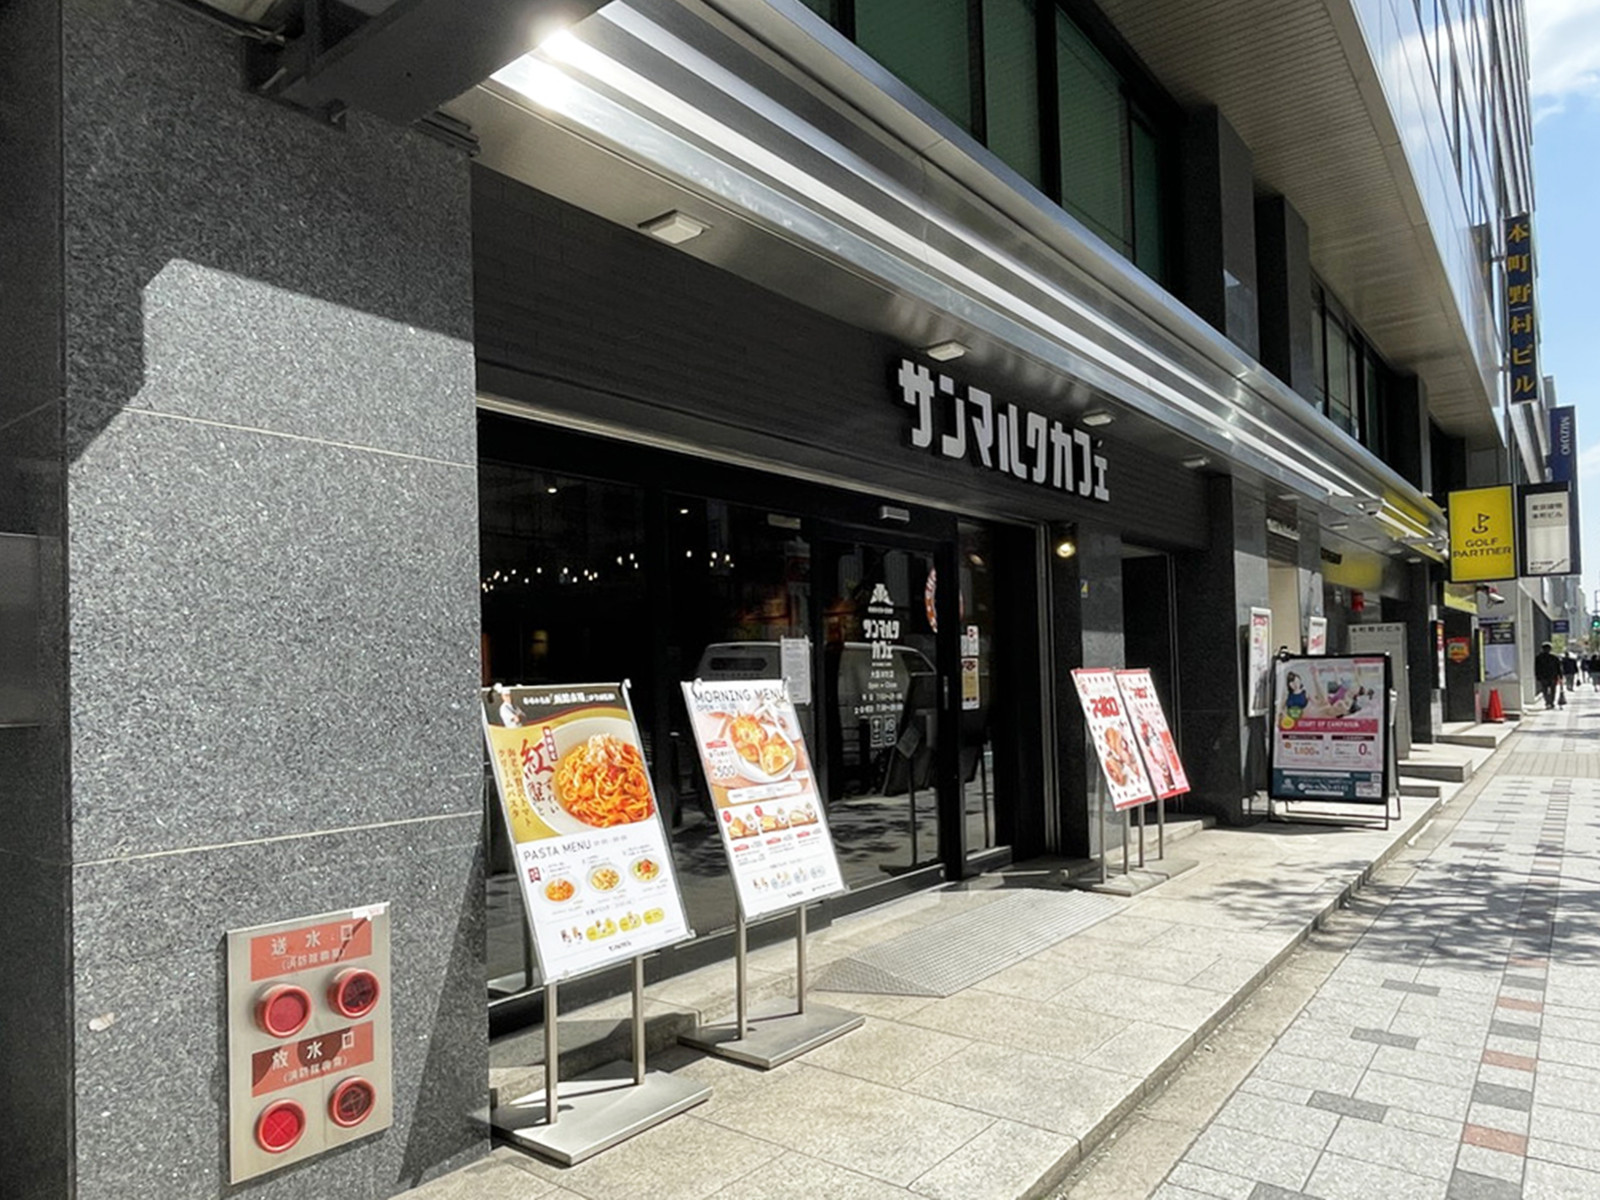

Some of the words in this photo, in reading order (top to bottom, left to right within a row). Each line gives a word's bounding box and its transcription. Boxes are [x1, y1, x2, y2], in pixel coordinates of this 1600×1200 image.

[1507, 223, 1535, 394] 本町野村ビル
[898, 358, 1111, 502] サンマルクカフェ
[1453, 546, 1511, 559] PARTNER
[1465, 537, 1499, 548] GOLF
[696, 689, 751, 703] MORNING
[520, 738, 555, 780] 紅
[523, 845, 559, 861] PASTA
[562, 839, 592, 853] MENU
[271, 924, 353, 956] 送水口
[271, 1031, 354, 1070] 放水口
